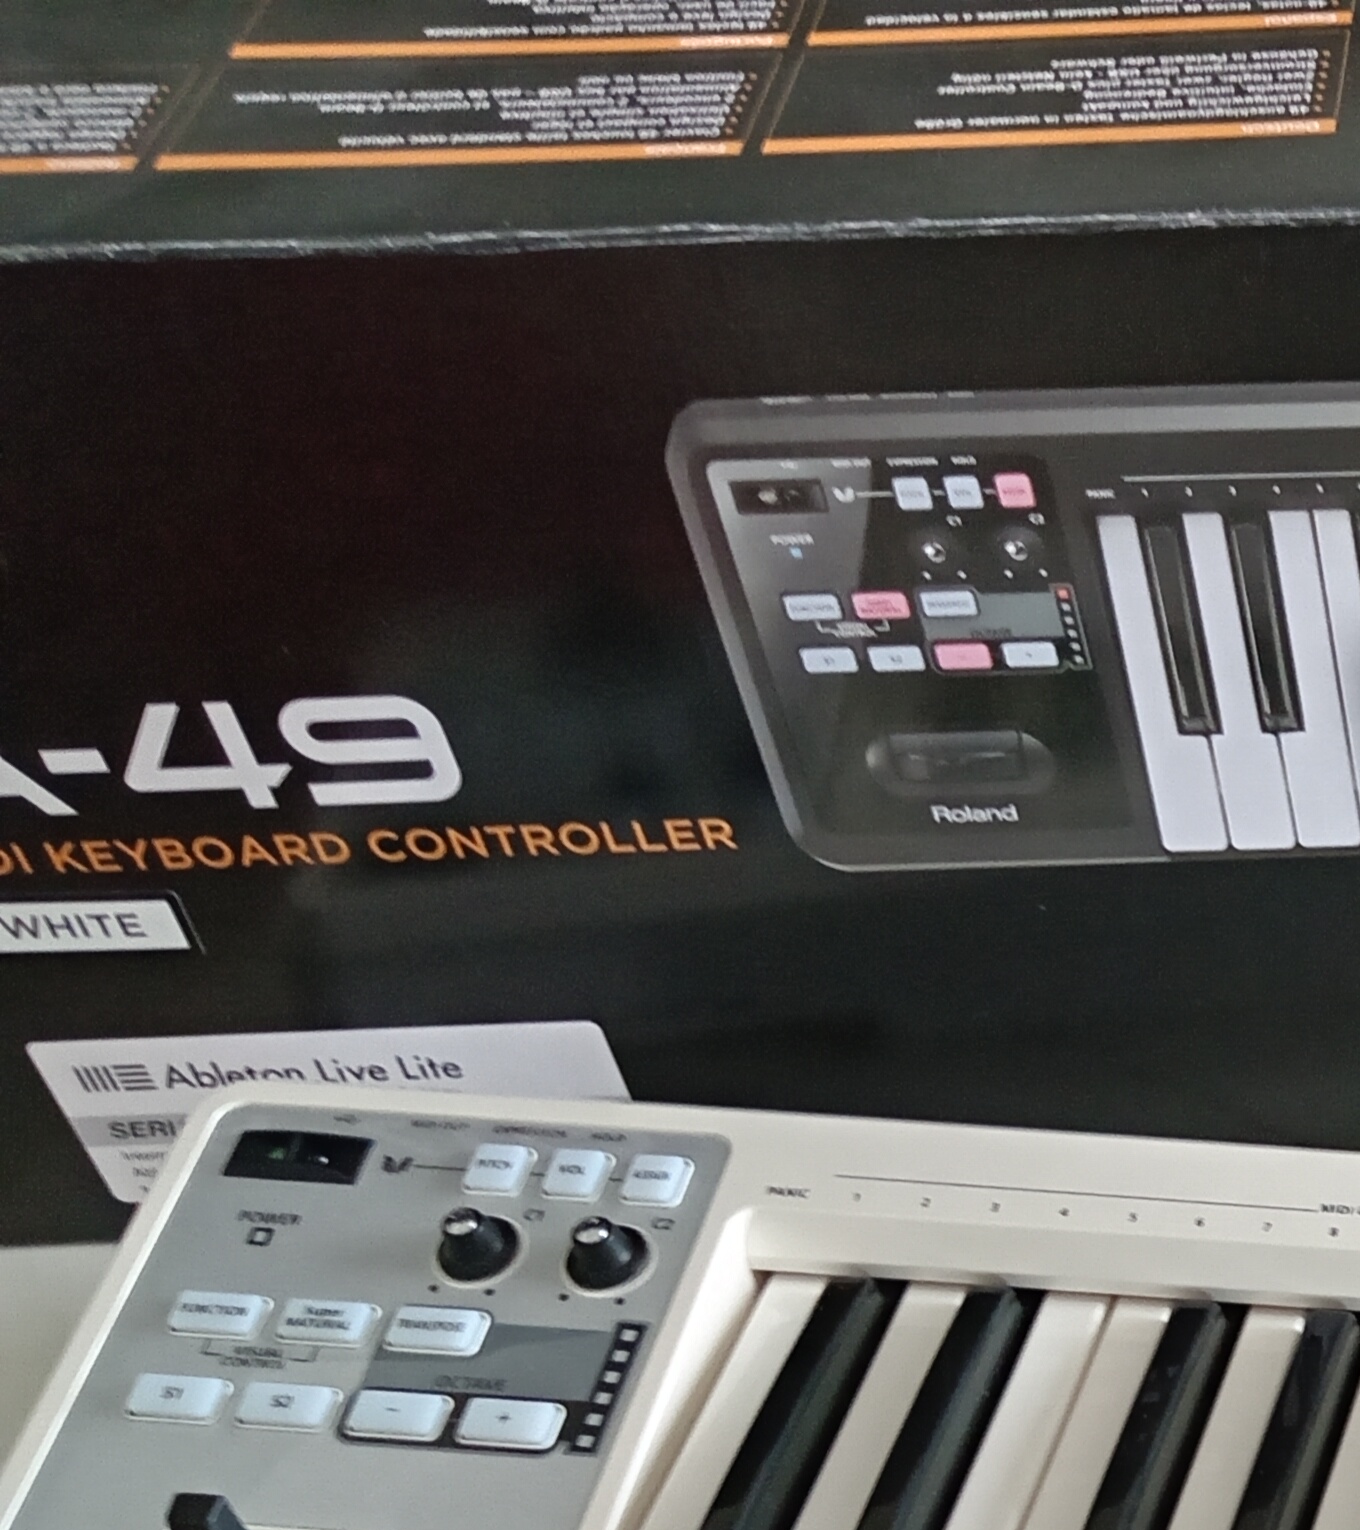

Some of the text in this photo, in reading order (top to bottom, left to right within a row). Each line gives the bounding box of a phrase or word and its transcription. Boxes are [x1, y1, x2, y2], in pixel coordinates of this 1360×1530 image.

[1241, 118, 1321, 134] Deutsch
[930, 804, 1020, 824] Roland
[49, 827, 350, 876] KEYBOARD
[366, 816, 740, 864] CONTROLLER
[1, 913, 148, 940] WHITE
[314, 1056, 391, 1083] Live
[396, 1052, 466, 1081] Lite
[767, 1187, 808, 1198] PANIC
[239, 1210, 302, 1225] POWER
[652, 1216, 675, 1230] C2
[434, 1375, 508, 1391] OCTAVE
[271, 1395, 296, 1408] S2
